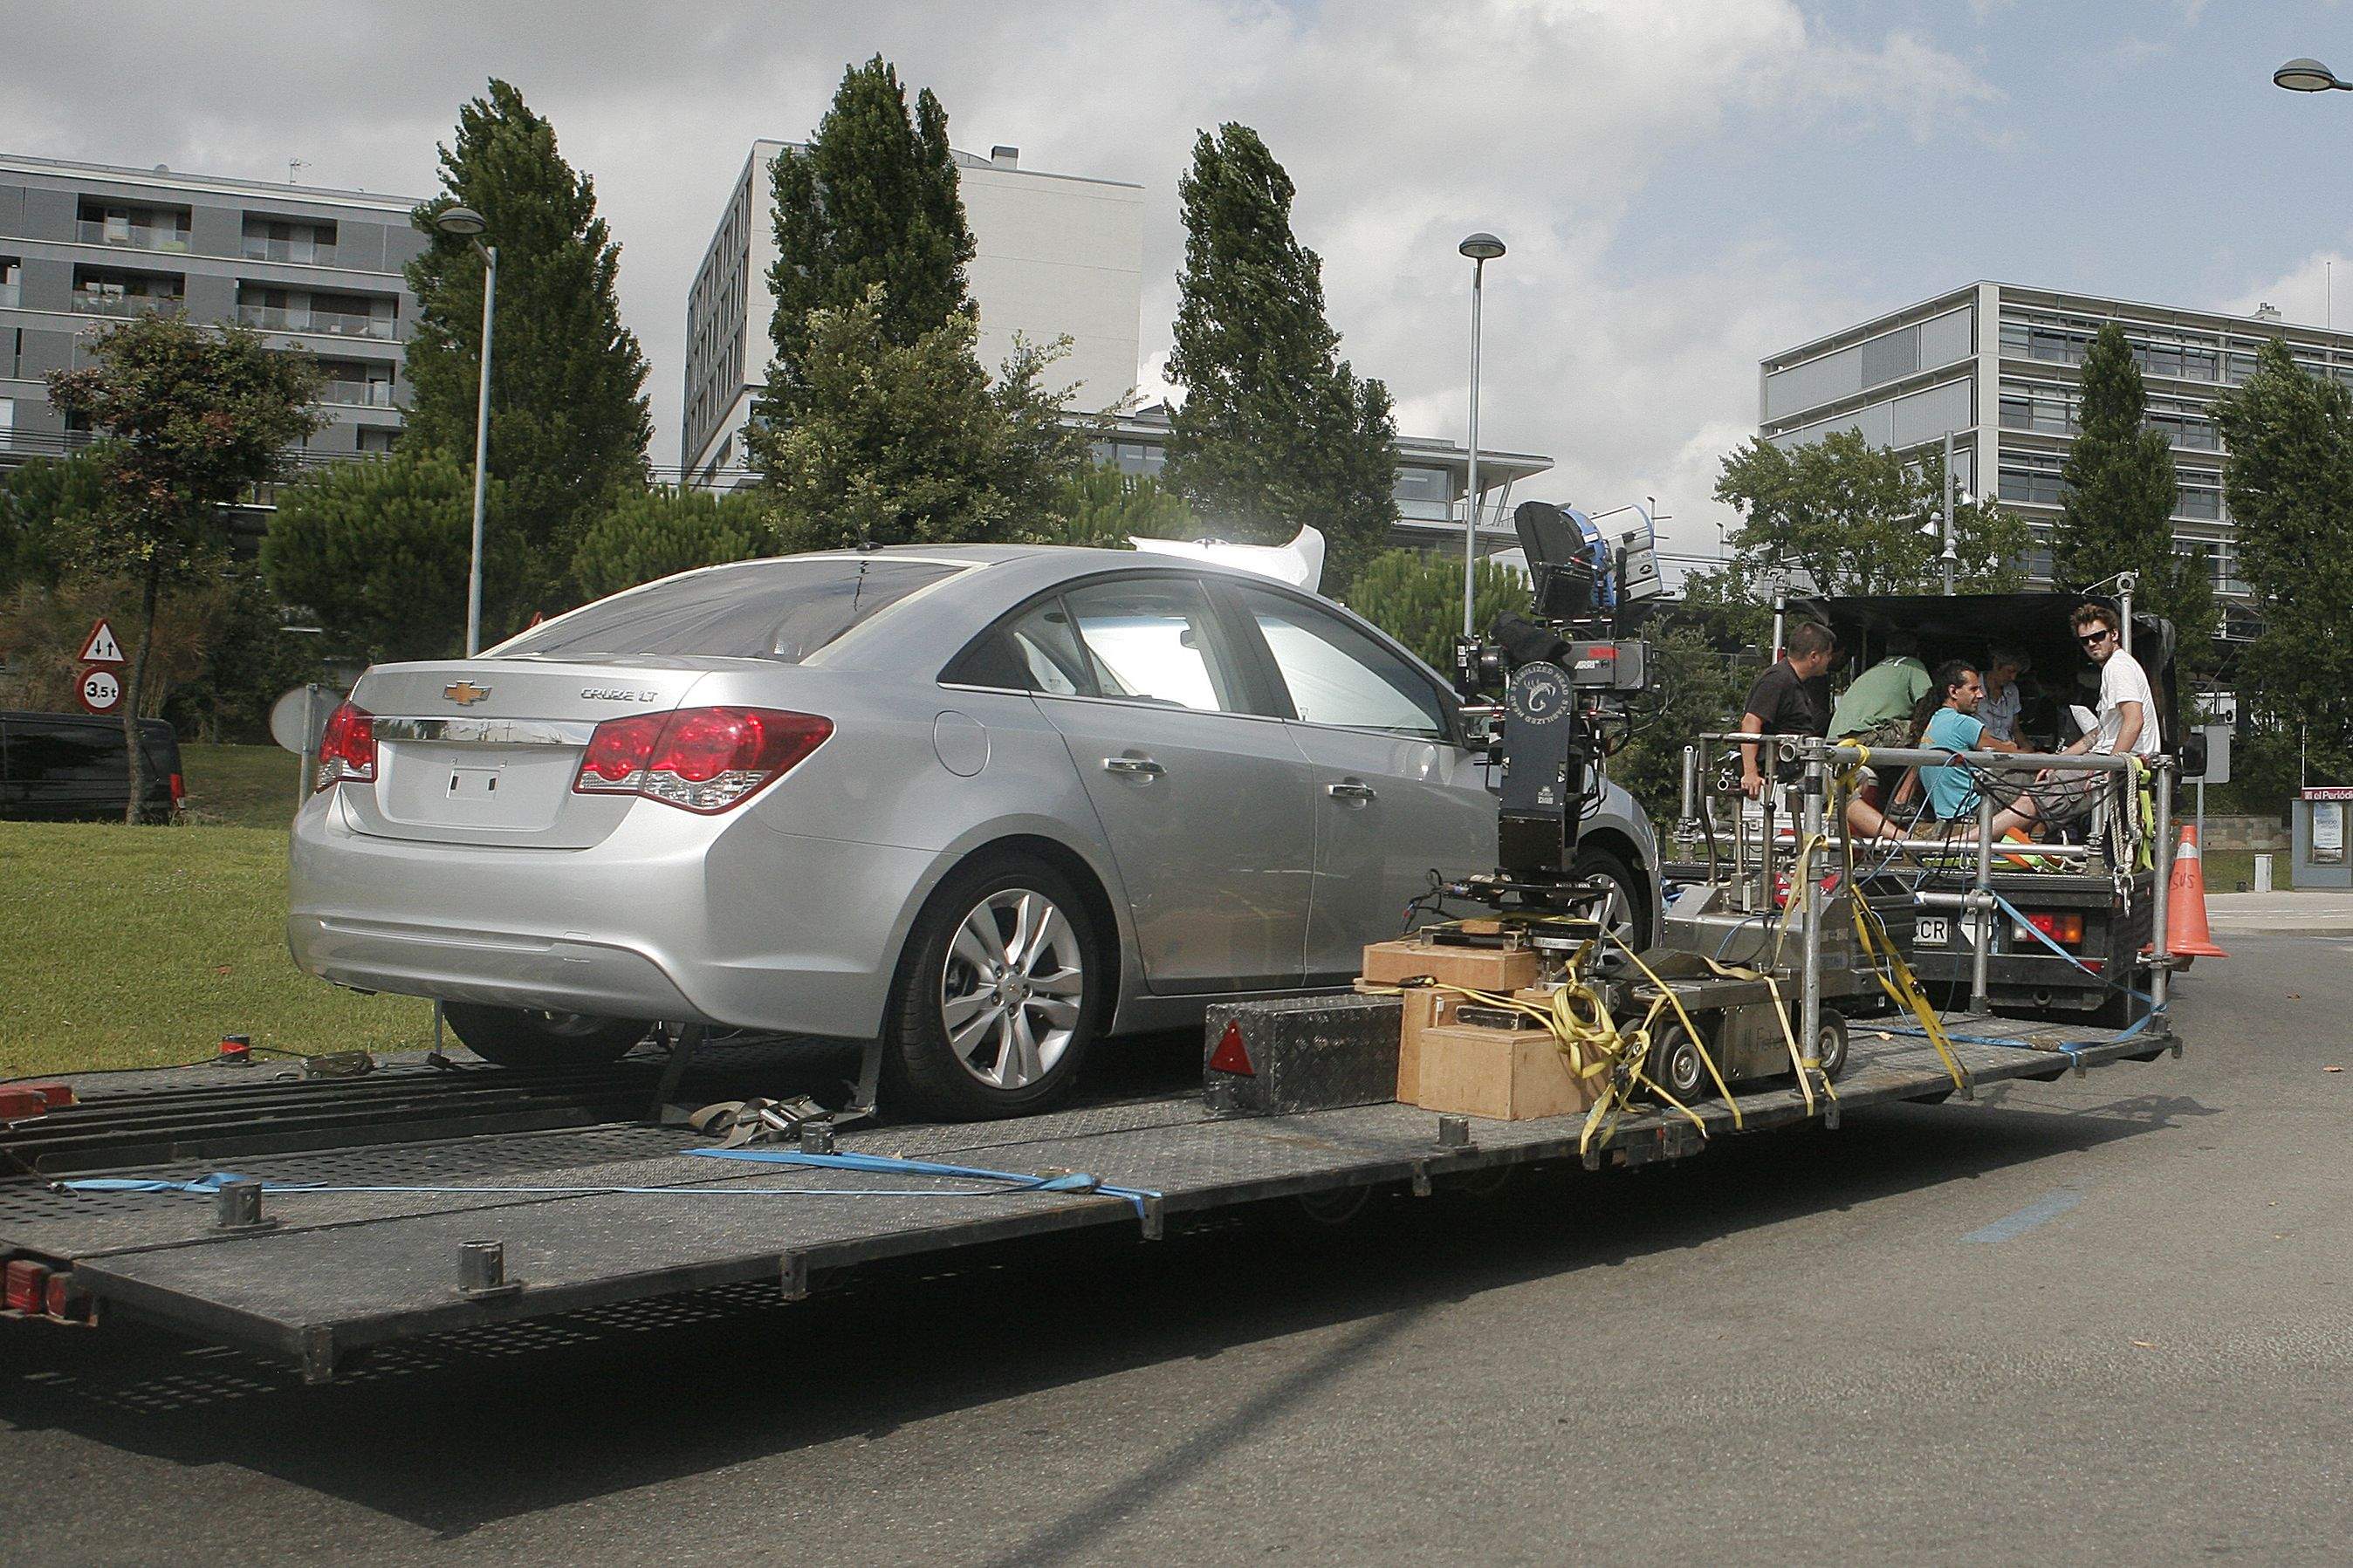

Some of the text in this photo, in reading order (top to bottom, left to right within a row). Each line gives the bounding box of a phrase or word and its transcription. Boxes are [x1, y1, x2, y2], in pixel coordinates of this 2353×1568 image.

[580, 688, 658, 702] CRUZE LT
[2313, 791, 2322, 800] el
[1913, 921, 1945, 940] CR
